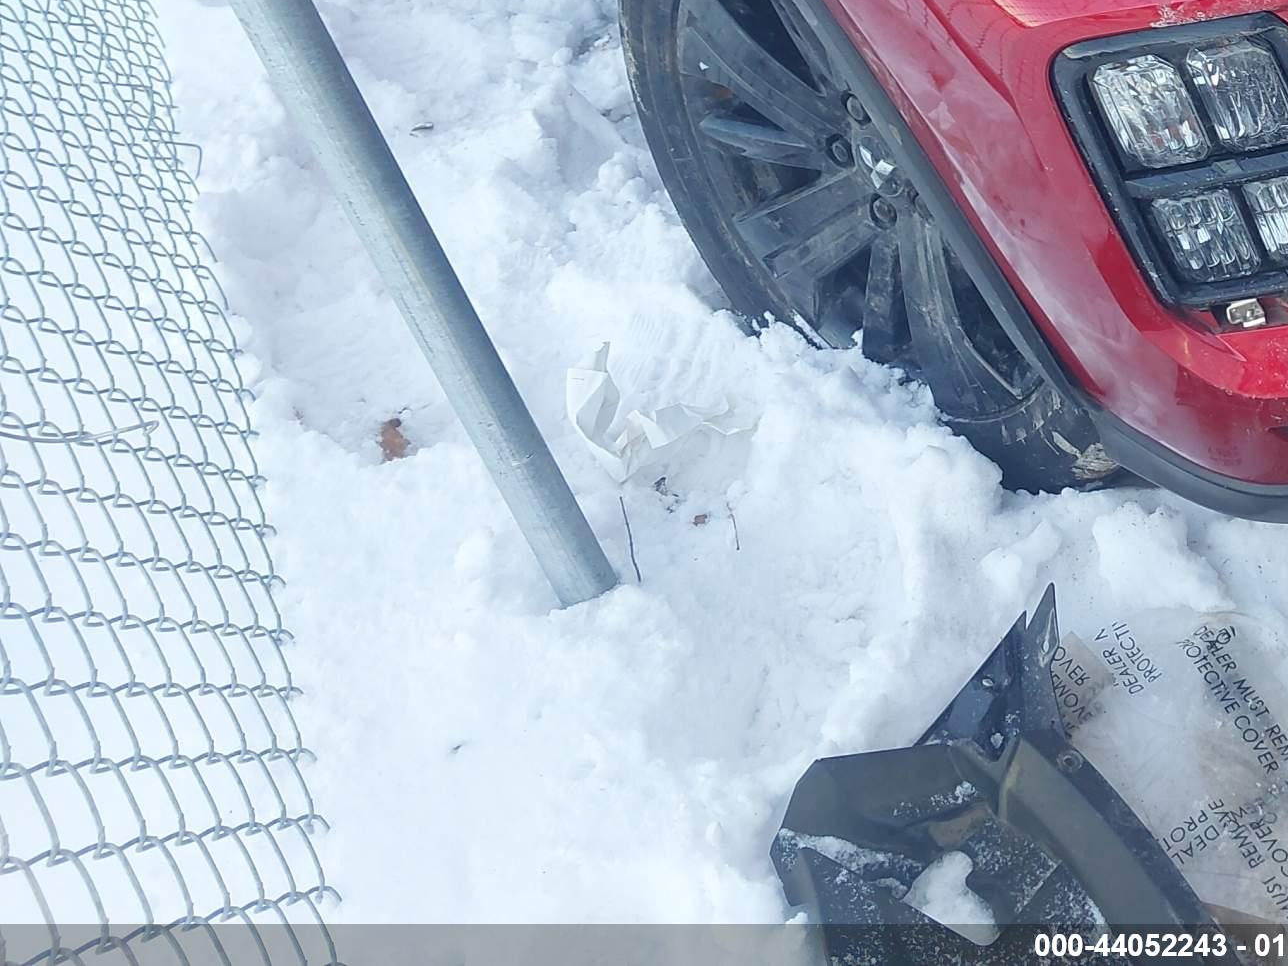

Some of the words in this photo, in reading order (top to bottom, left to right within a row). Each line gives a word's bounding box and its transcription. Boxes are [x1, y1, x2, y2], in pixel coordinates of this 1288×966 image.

[1102, 647, 1145, 696] DEALER
[1177, 638, 1240, 714] PROTECTIVE
[1234, 714, 1280, 775] COVER
[1193, 625, 1238, 674] DEALER
[1231, 678, 1271, 719] MUST
